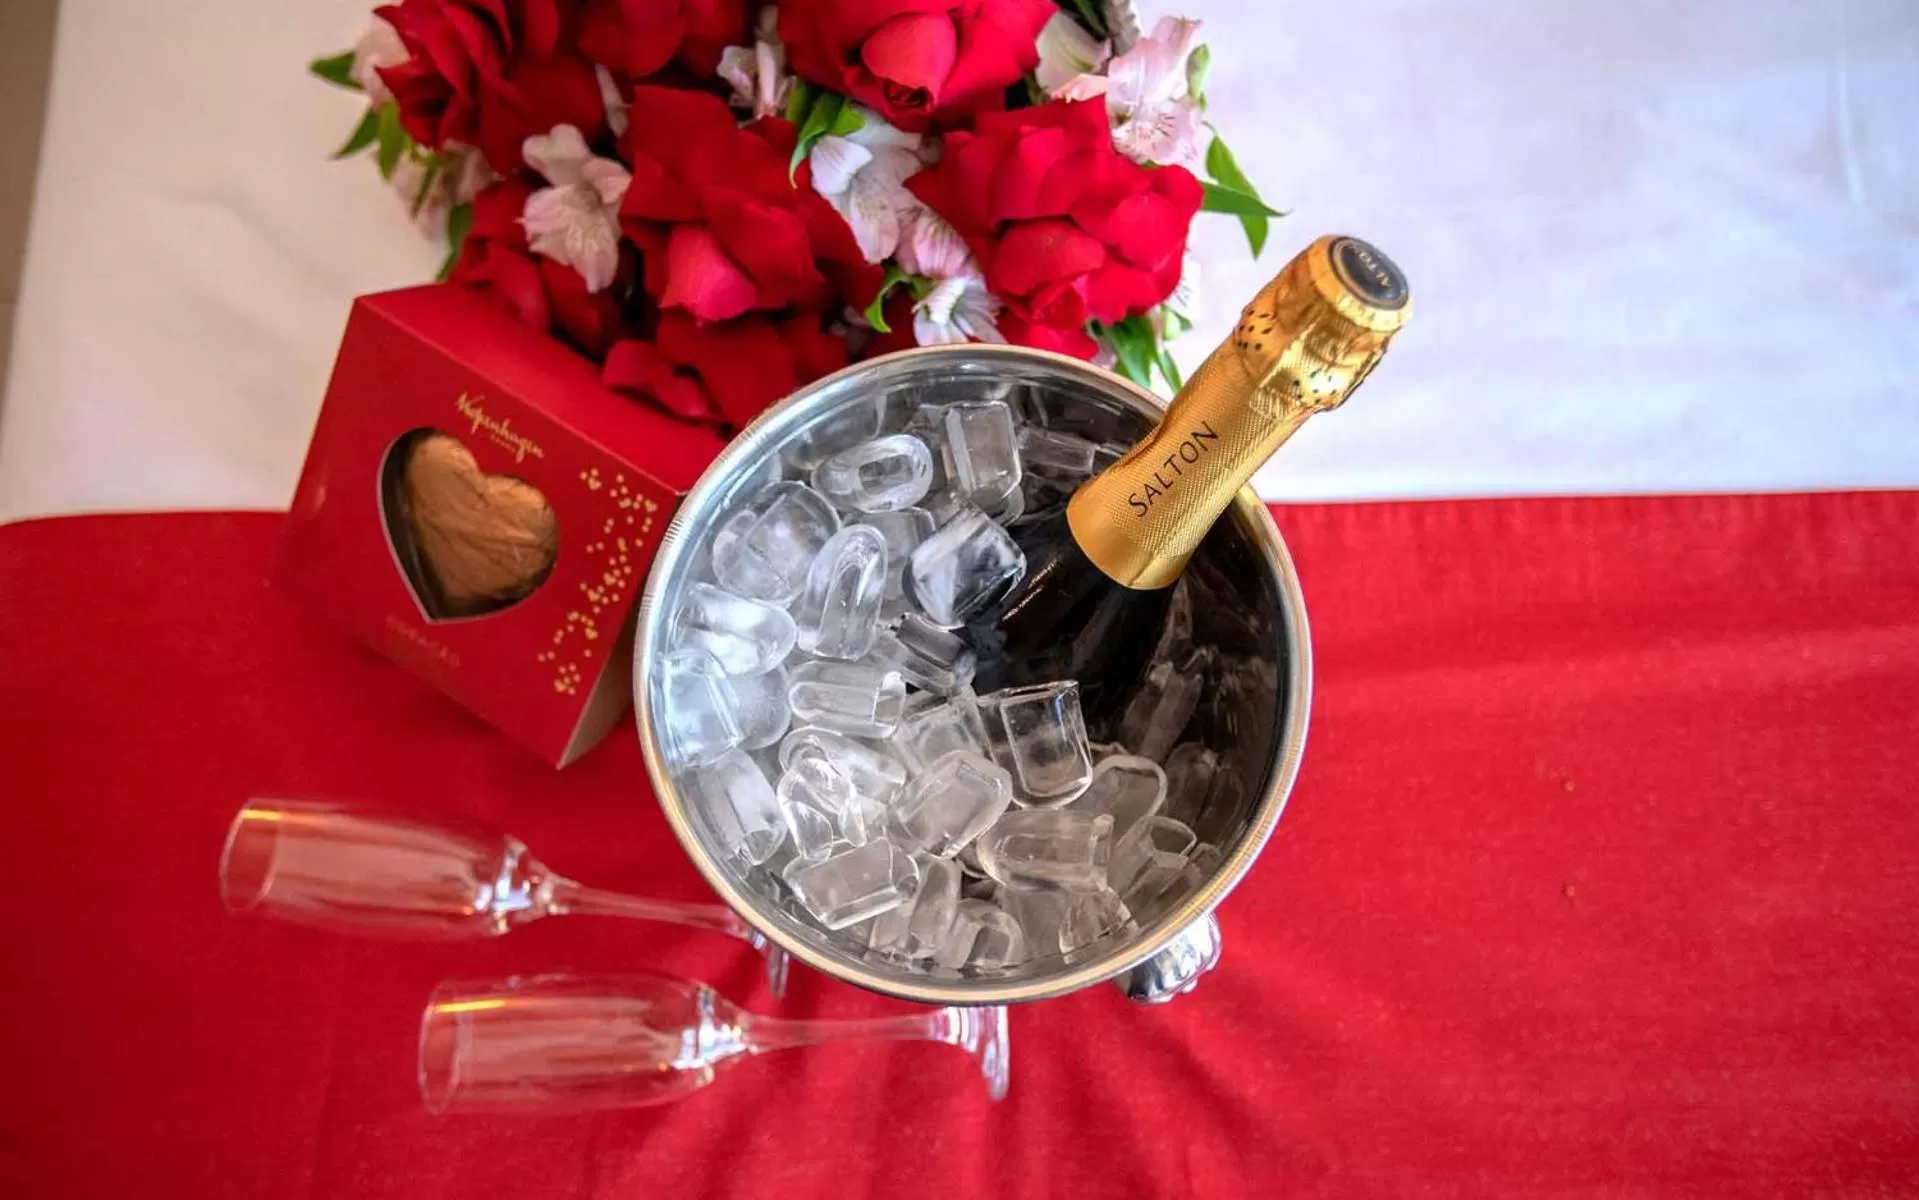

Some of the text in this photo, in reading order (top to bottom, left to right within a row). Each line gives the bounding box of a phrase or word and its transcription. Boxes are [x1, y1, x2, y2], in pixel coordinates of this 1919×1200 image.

[1349, 245, 1393, 294] ALTO
[455, 392, 544, 463] Kopenhagen
[1128, 421, 1218, 517] SALTON
